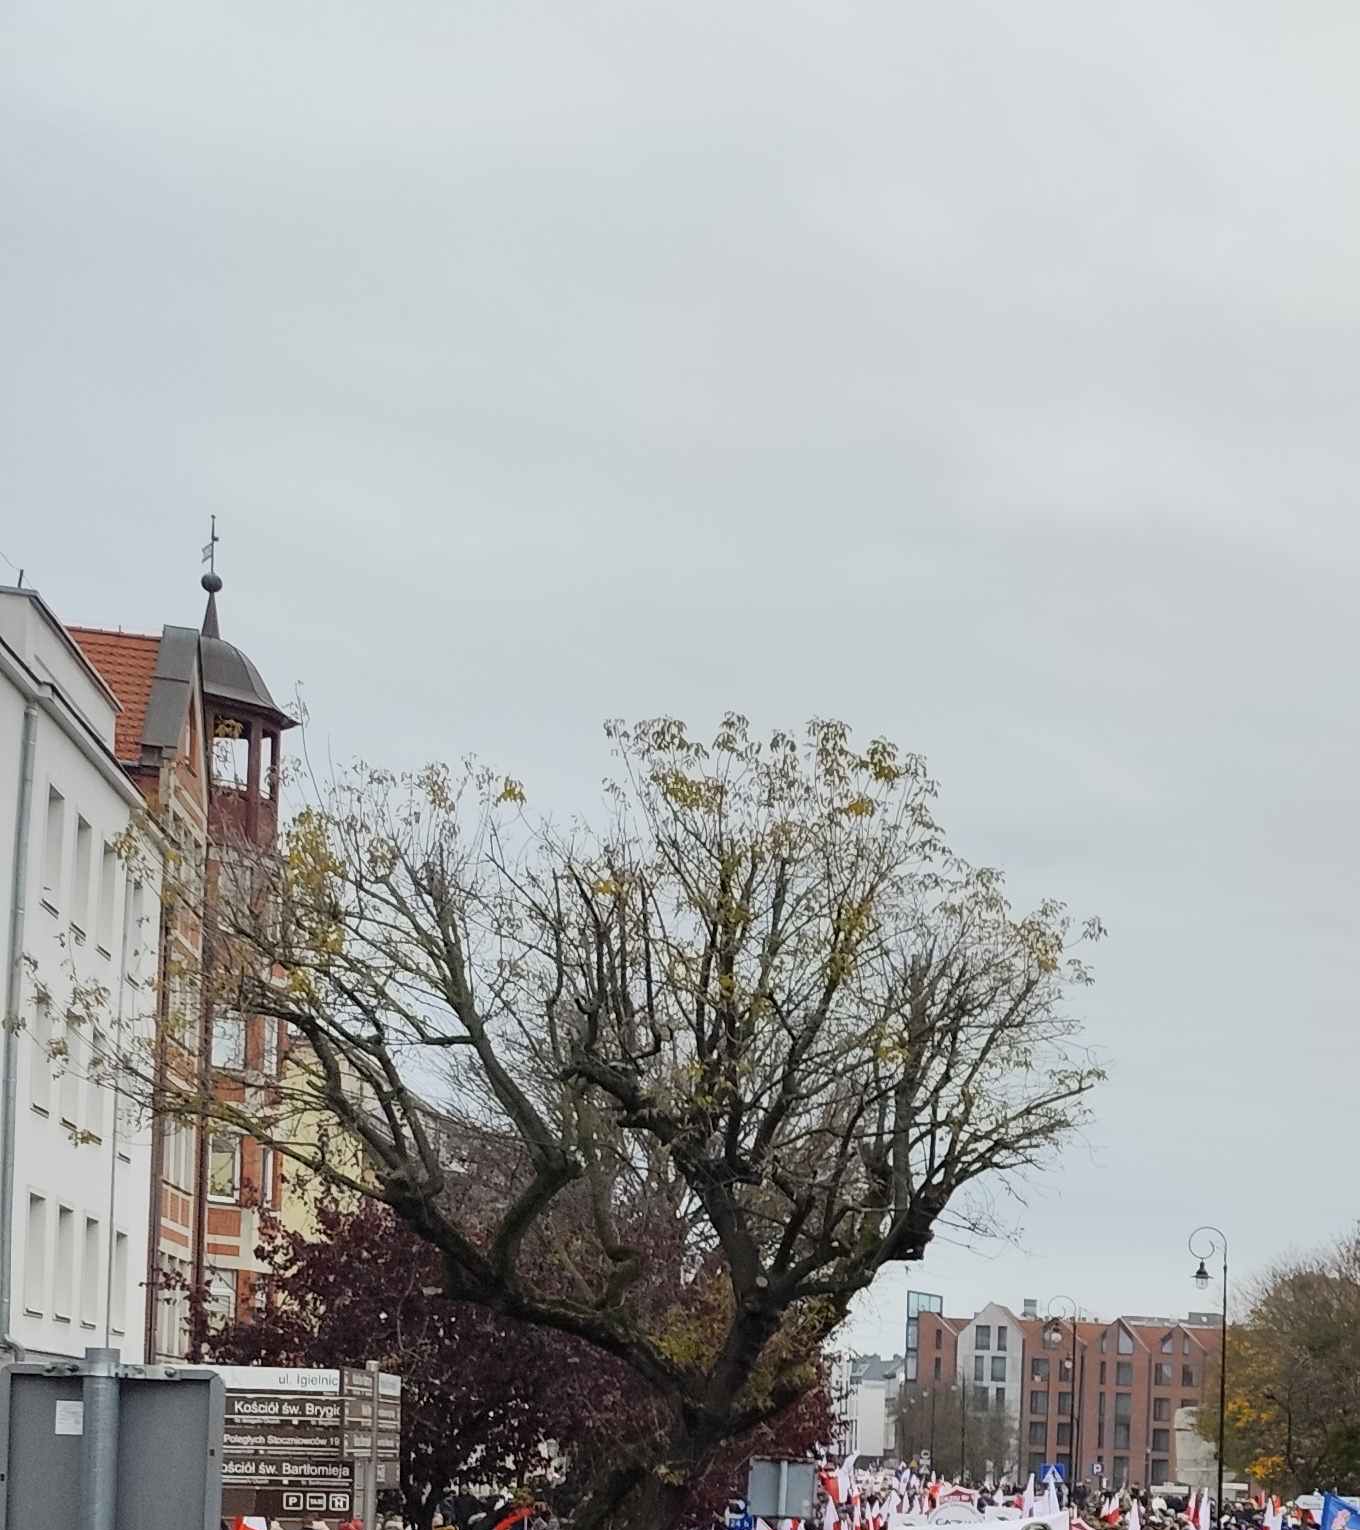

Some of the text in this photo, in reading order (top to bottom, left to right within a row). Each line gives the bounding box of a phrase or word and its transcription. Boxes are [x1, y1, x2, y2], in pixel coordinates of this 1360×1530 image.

[234, 1400, 279, 1414] Kościół
[282, 1402, 302, 1415] św.
[221, 1460, 350, 1478] ościół św. Bartłomieja
